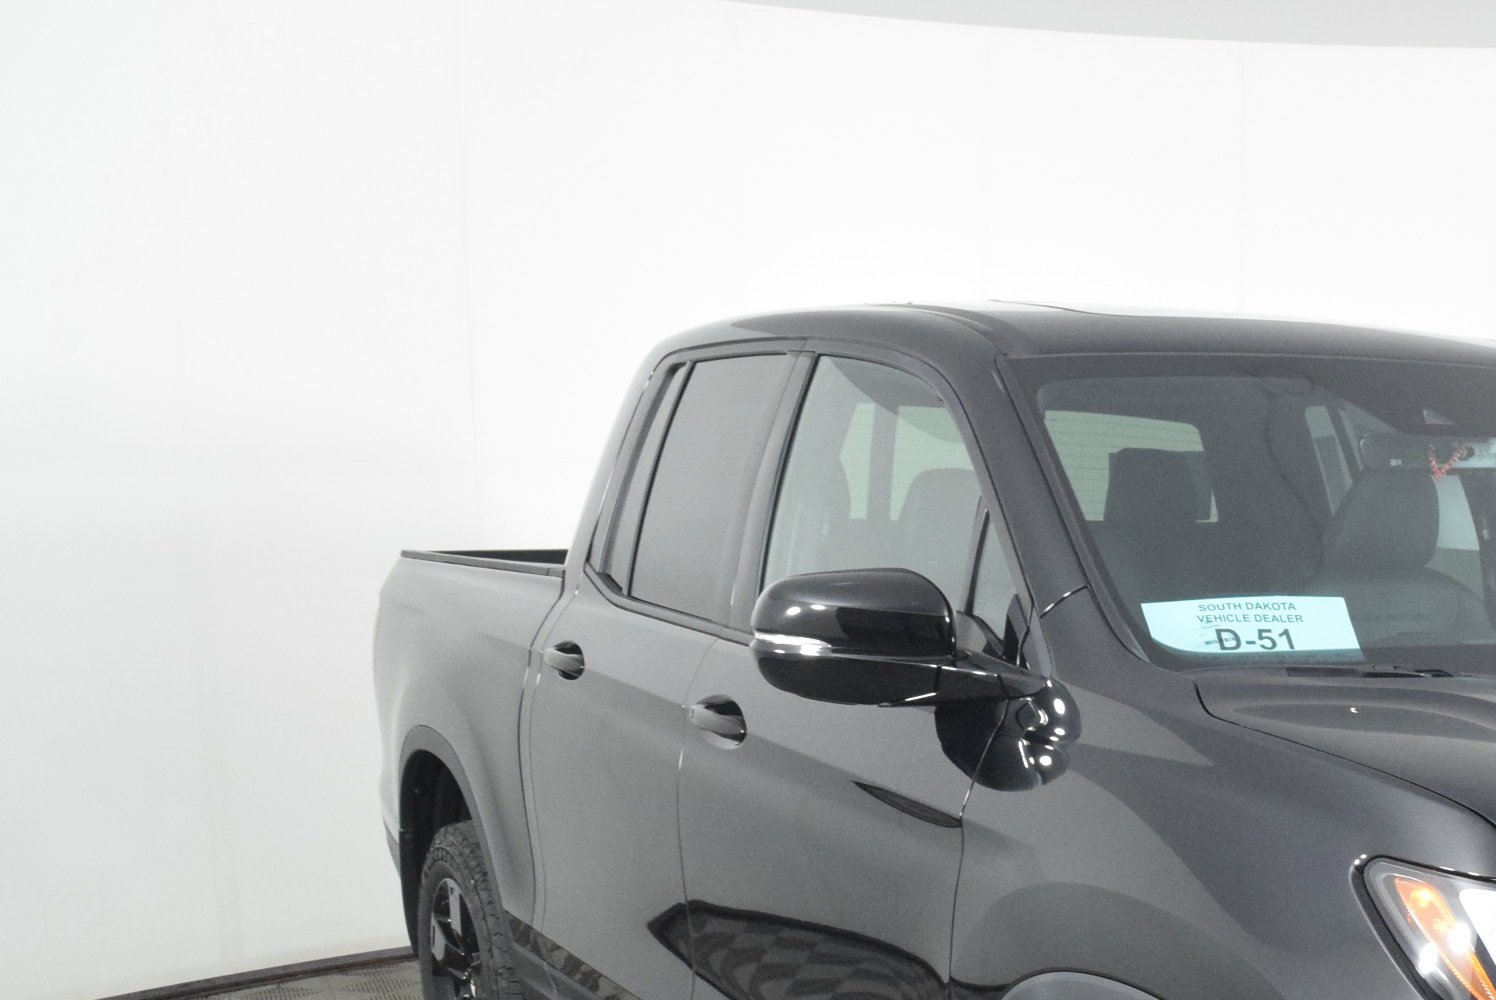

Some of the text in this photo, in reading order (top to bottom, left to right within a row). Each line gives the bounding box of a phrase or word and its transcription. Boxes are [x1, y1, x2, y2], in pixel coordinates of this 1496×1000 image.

[1198, 602, 1296, 612] SOUTH DAKOTA
[1196, 614, 1304, 623] VEHICLE DEALER
[1214, 628, 1296, 650] D-51
